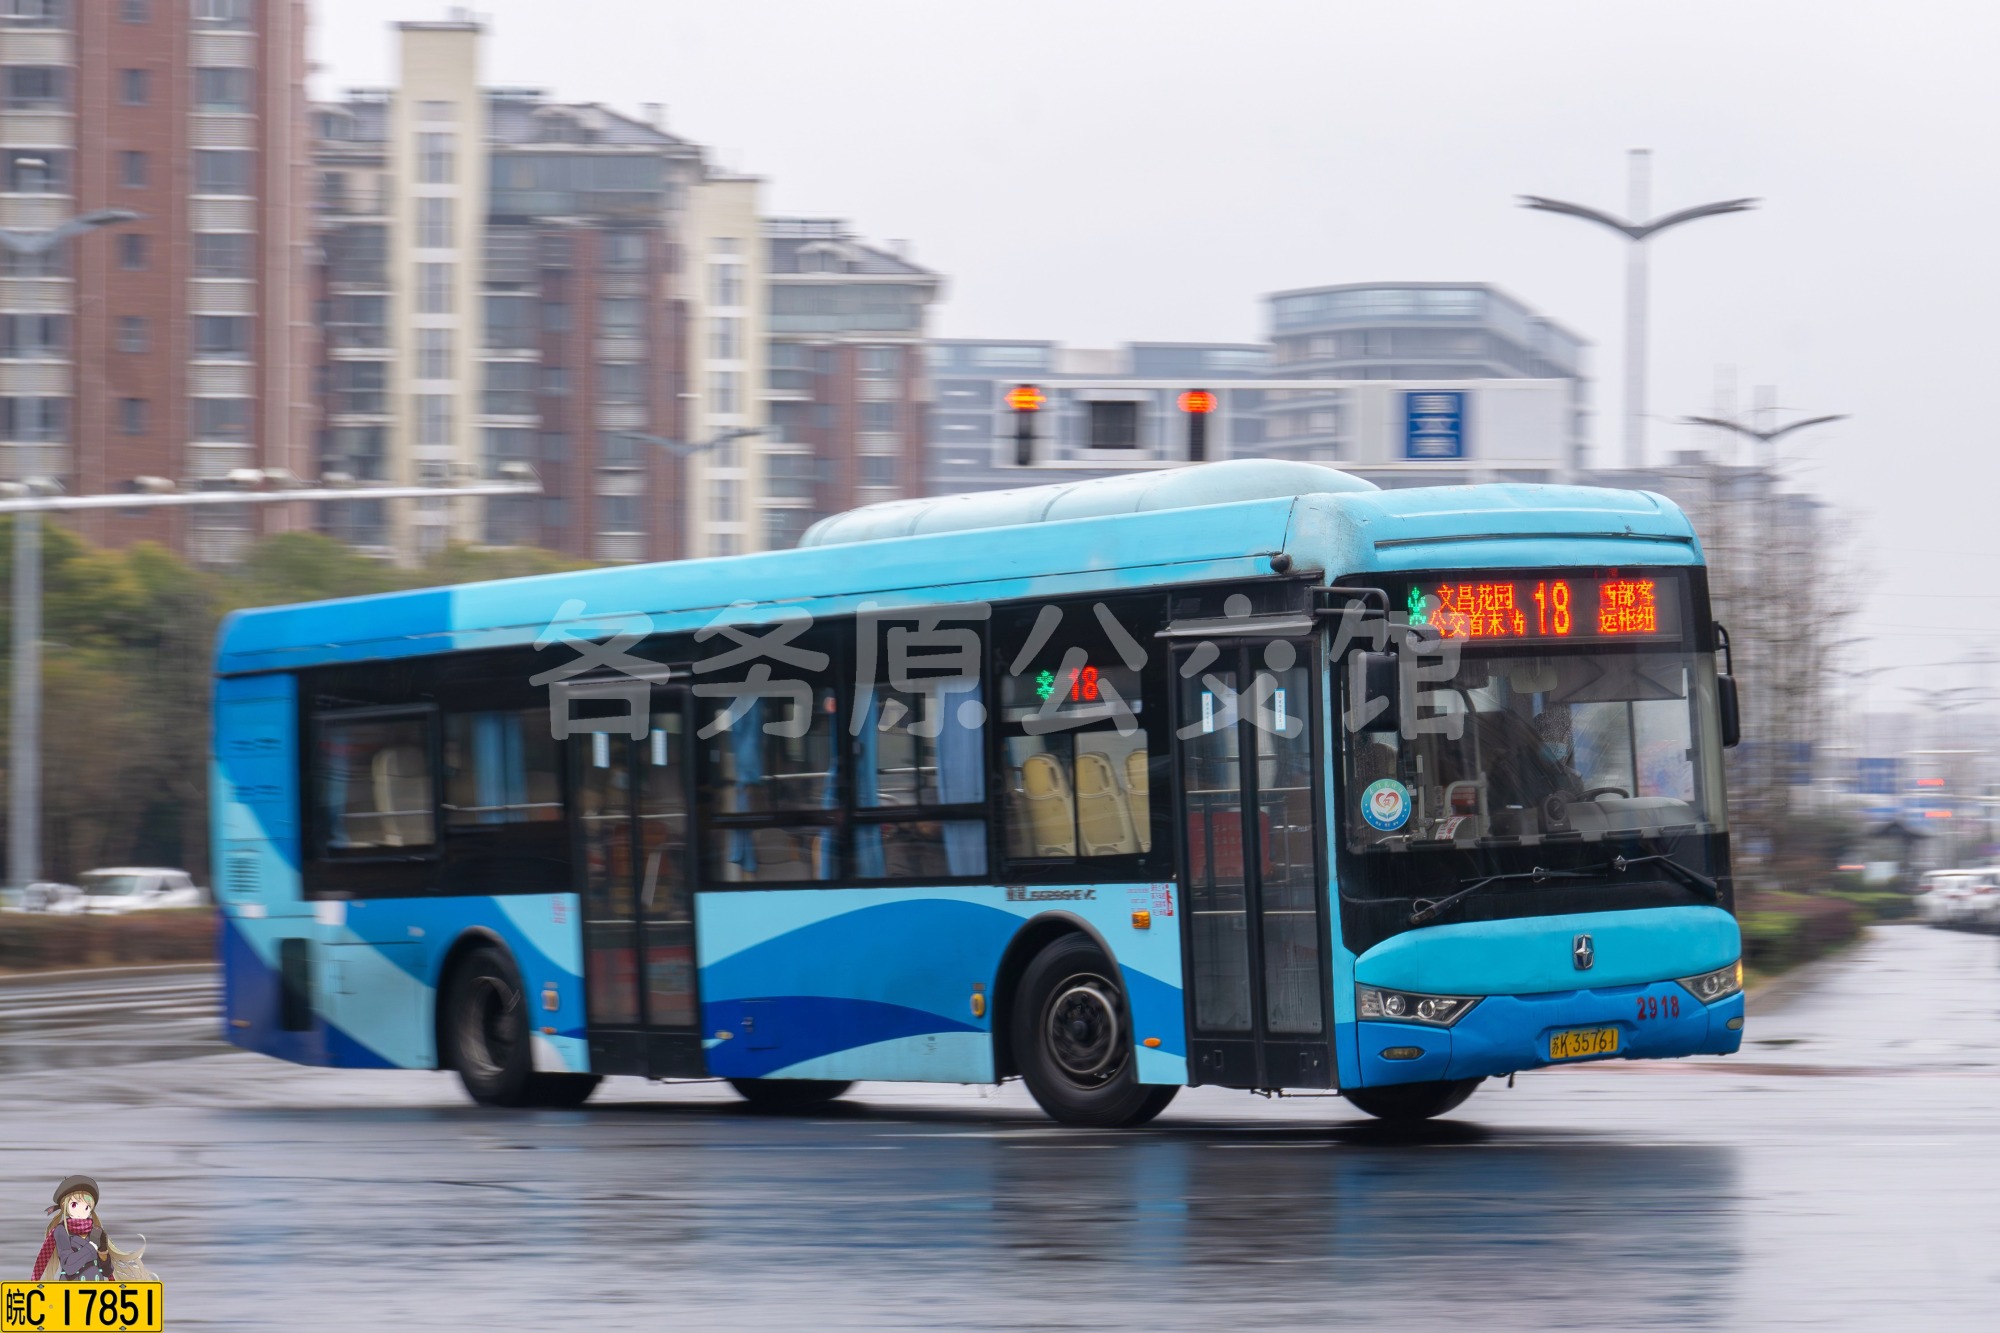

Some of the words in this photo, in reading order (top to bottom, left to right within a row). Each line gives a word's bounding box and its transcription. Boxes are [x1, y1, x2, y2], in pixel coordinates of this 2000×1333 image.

[1437, 584, 1513, 611] 文昌花园
[1535, 581, 1570, 634] 18
[1068, 665, 1099, 701] 18
[1636, 995, 1680, 1020] 2918
